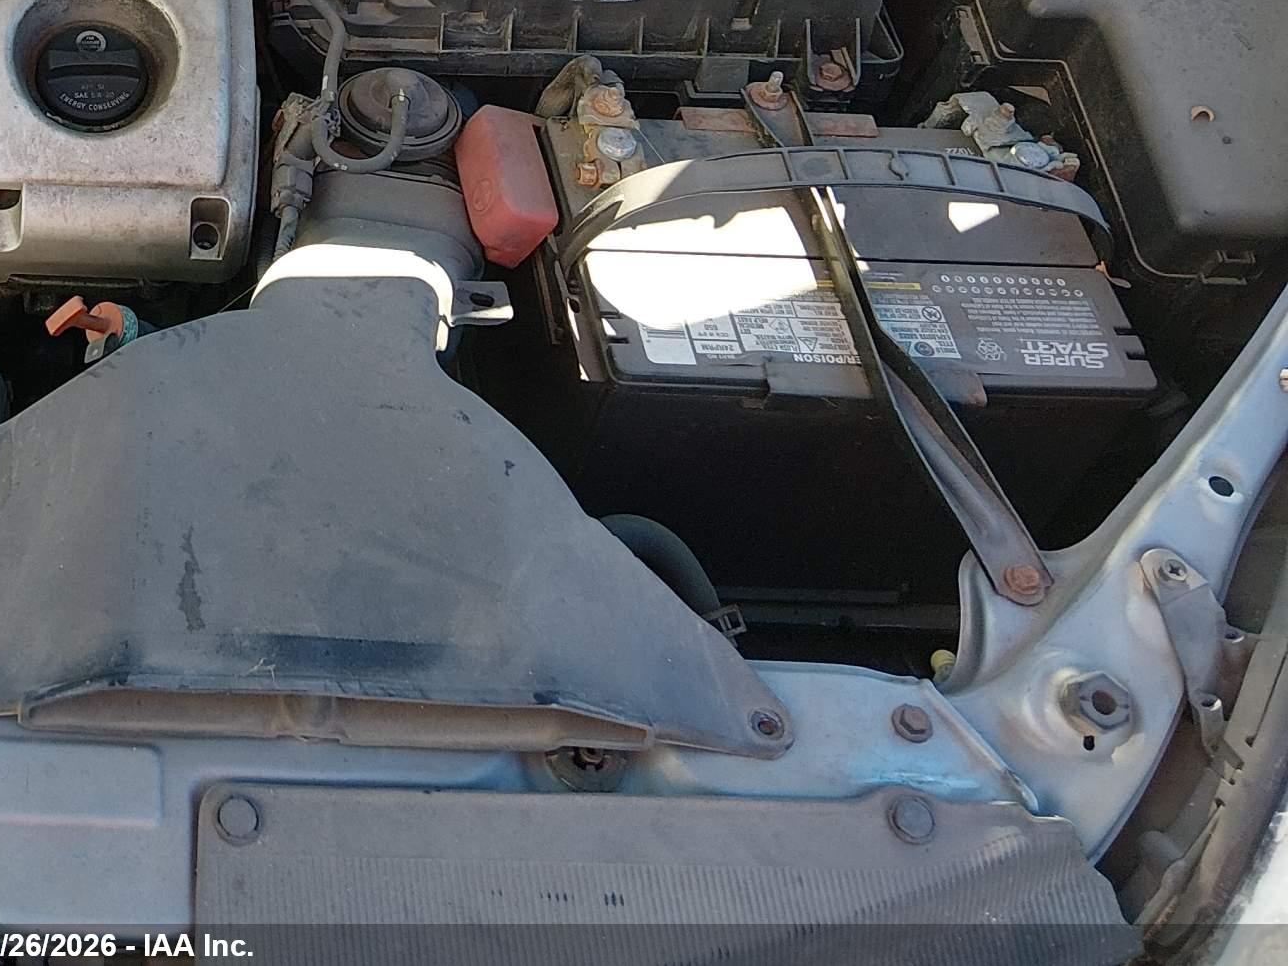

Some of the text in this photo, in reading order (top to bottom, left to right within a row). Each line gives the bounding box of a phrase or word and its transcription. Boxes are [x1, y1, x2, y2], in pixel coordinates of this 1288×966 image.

[59, 91, 130, 111] ENERGY CONSERVING
[1021, 341, 1109, 358] START
[1023, 353, 1105, 369] SUPER
